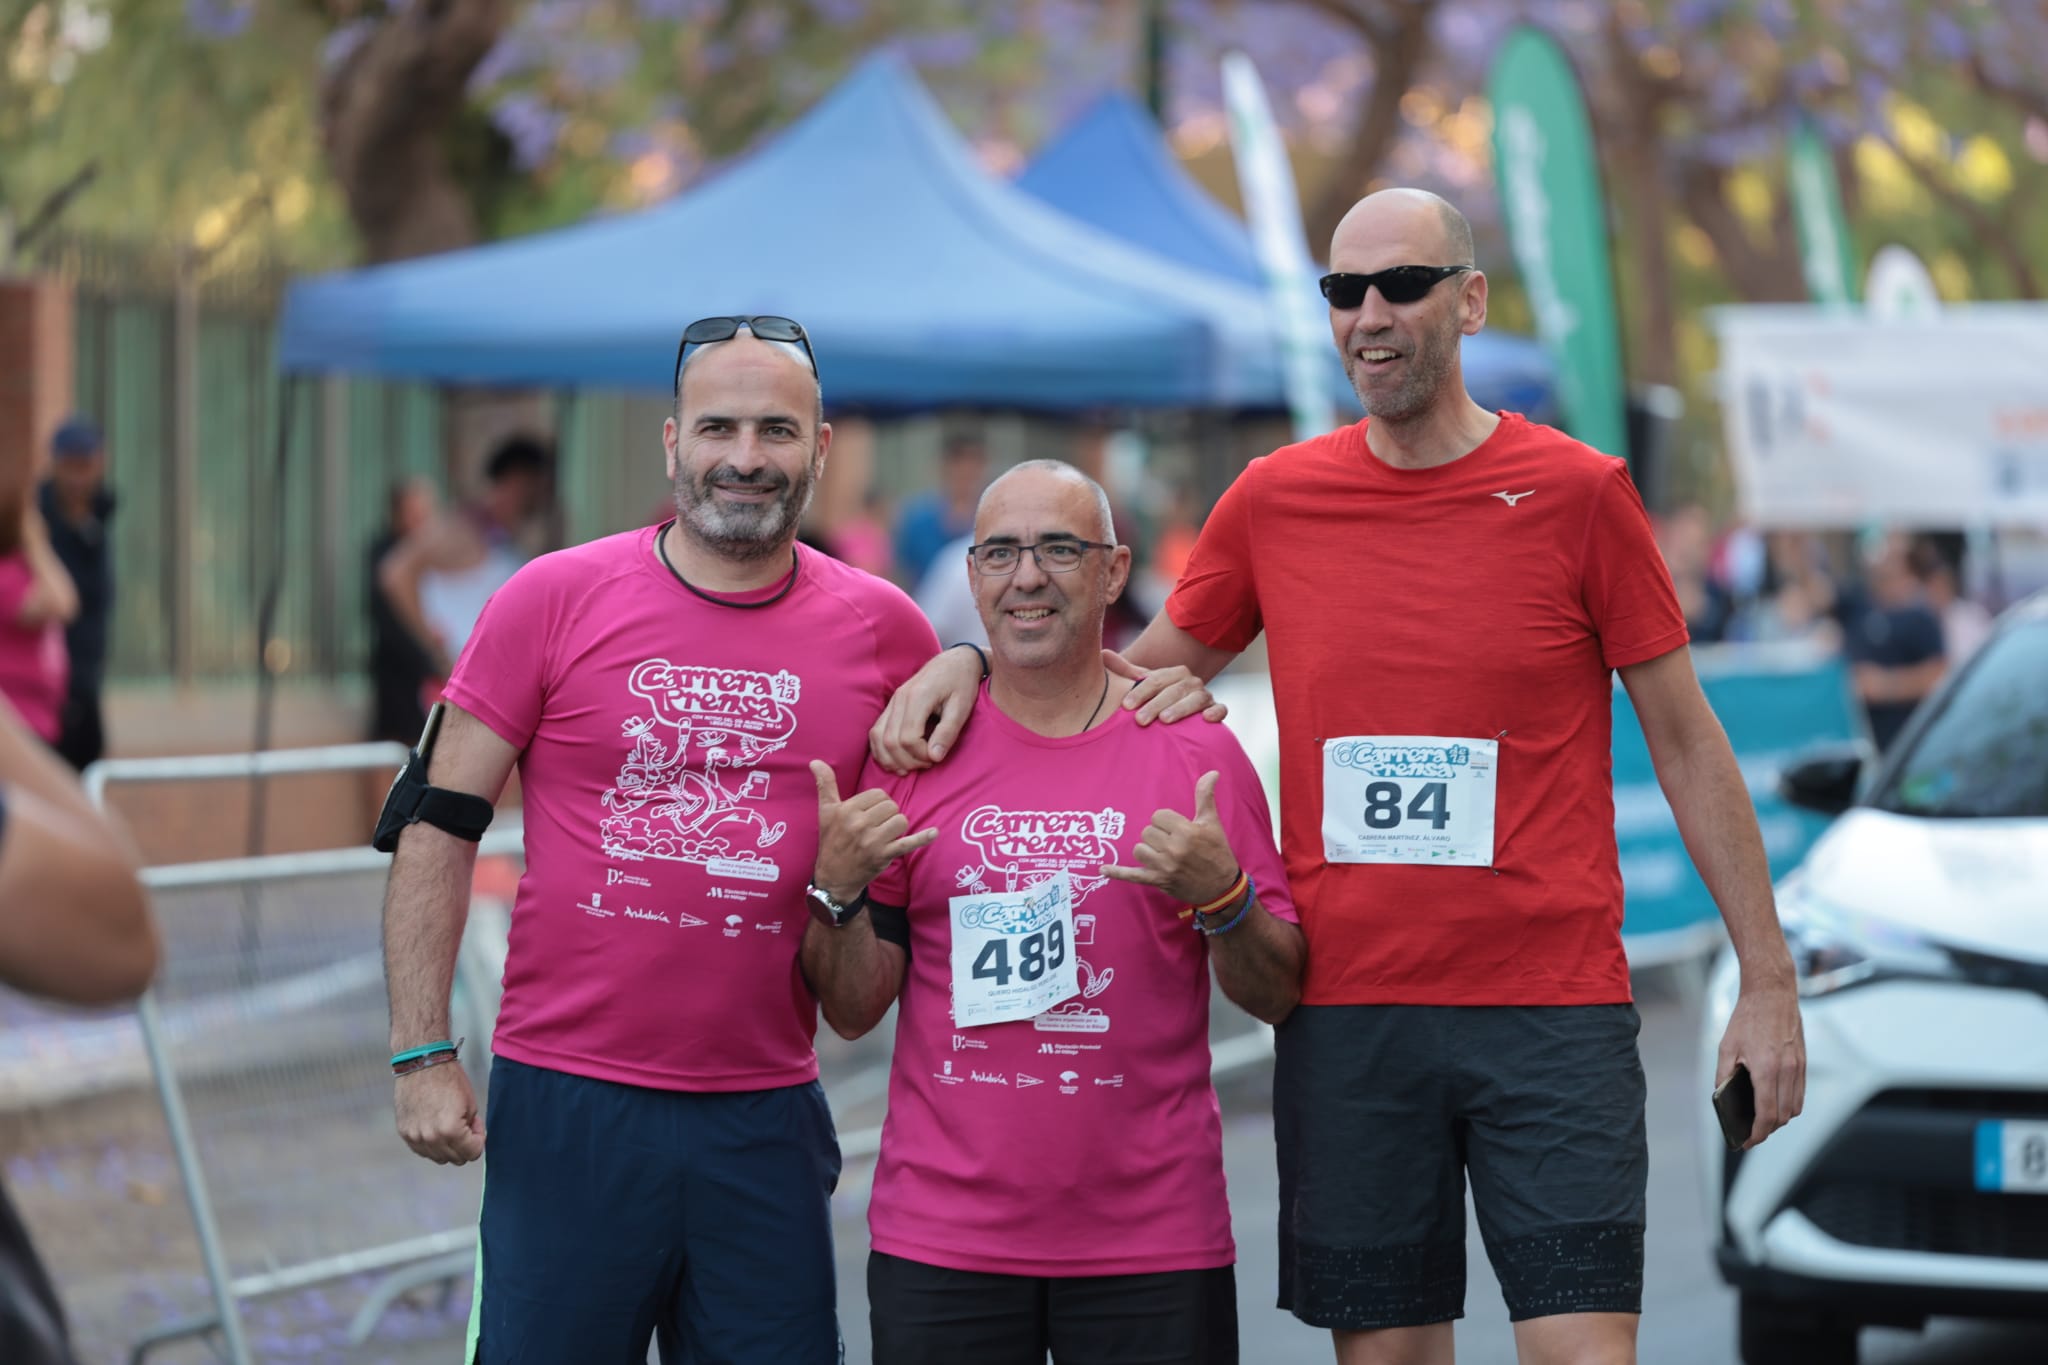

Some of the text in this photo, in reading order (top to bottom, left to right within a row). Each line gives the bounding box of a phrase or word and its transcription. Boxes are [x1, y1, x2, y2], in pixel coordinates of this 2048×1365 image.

[641, 669, 773, 696] Carrera
[776, 674, 796, 687] de
[776, 686, 796, 699] la
[1354, 745, 1448, 764] Carrera
[1373, 762, 1454, 777] Prensa
[1364, 781, 1450, 830] 84
[971, 812, 1096, 834] Carrera
[1099, 811, 1120, 824] de
[1099, 823, 1119, 836] la
[992, 834, 1101, 857] Prensa
[972, 919, 1064, 985] 489
